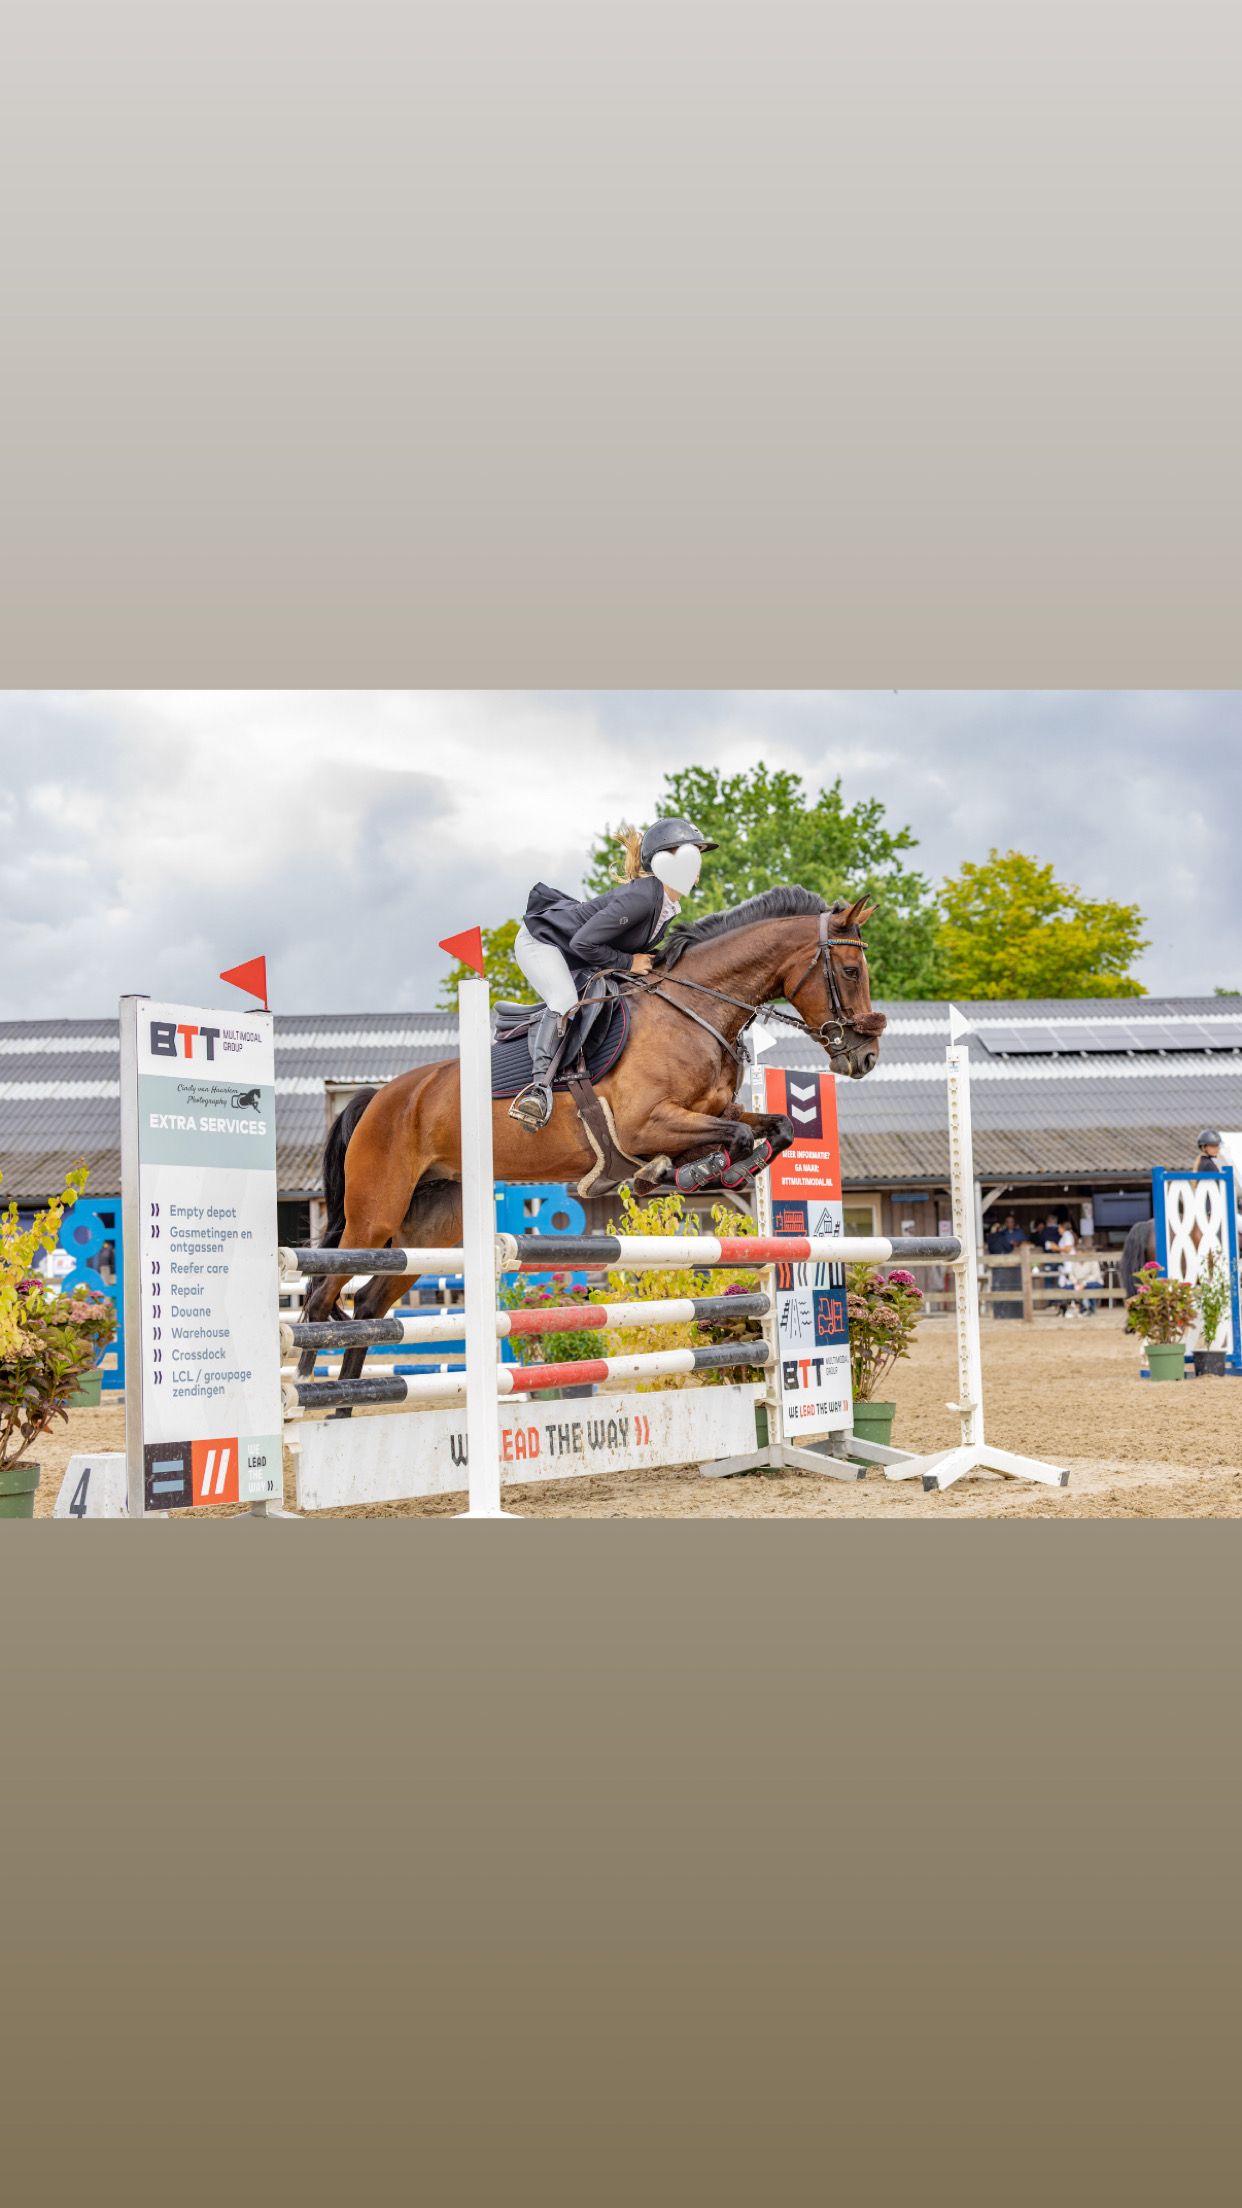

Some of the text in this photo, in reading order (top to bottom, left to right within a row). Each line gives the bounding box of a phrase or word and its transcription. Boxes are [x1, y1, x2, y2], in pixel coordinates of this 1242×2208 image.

[150, 1021, 220, 1060] BTT
[222, 1029, 263, 1043] MULTIMODAL
[222, 1041, 243, 1053] GROUP
[149, 1113, 267, 1135] EXTRA SERVICES
[169, 1204, 237, 1220] Empty depot
[169, 1226, 253, 1241] Gasmetingen en
[169, 1242, 224, 1255] ontgassen
[170, 1262, 229, 1274] Reefer care
[170, 1284, 204, 1298] Repair
[171, 1305, 211, 1317] Douane
[171, 1326, 230, 1339] Warehouse
[171, 1347, 226, 1361] Crossdock
[172, 1371, 194, 1383] LCL
[204, 1370, 252, 1384] groupage
[783, 1358, 824, 1390] BTT
[172, 1385, 225, 1398] zendingen
[788, 1400, 842, 1418] WE LEAD THE WAY
[247, 1443, 260, 1455] WE
[450, 1417, 628, 1467] W EAD THE WAY
[247, 1456, 267, 1468] LEAD
[248, 1468, 263, 1480] THE
[69, 1468, 91, 1519] 4
